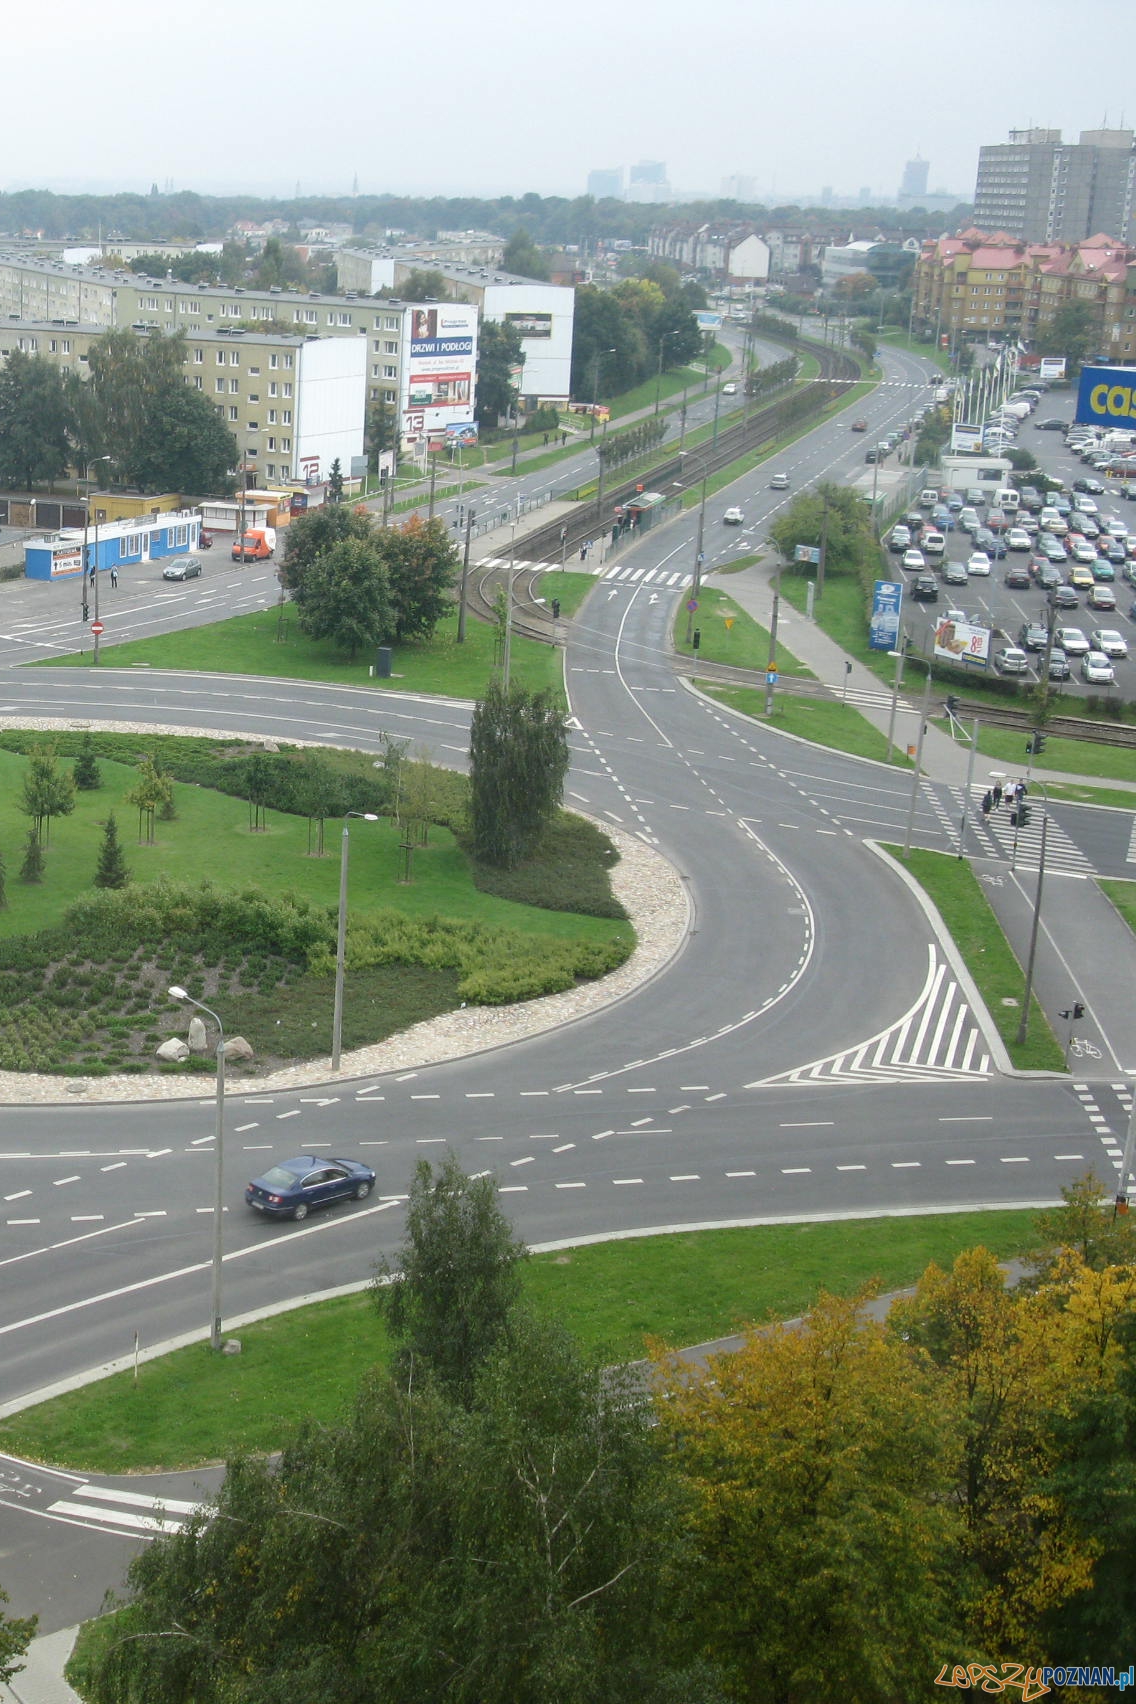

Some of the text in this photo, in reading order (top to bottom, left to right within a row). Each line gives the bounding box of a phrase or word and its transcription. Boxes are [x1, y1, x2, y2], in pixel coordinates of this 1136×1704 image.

[412, 343, 434, 352] DRZWI
[441, 342, 472, 351] PODŁOGI
[406, 416, 424, 432] 13
[302, 462, 320, 478] 12
